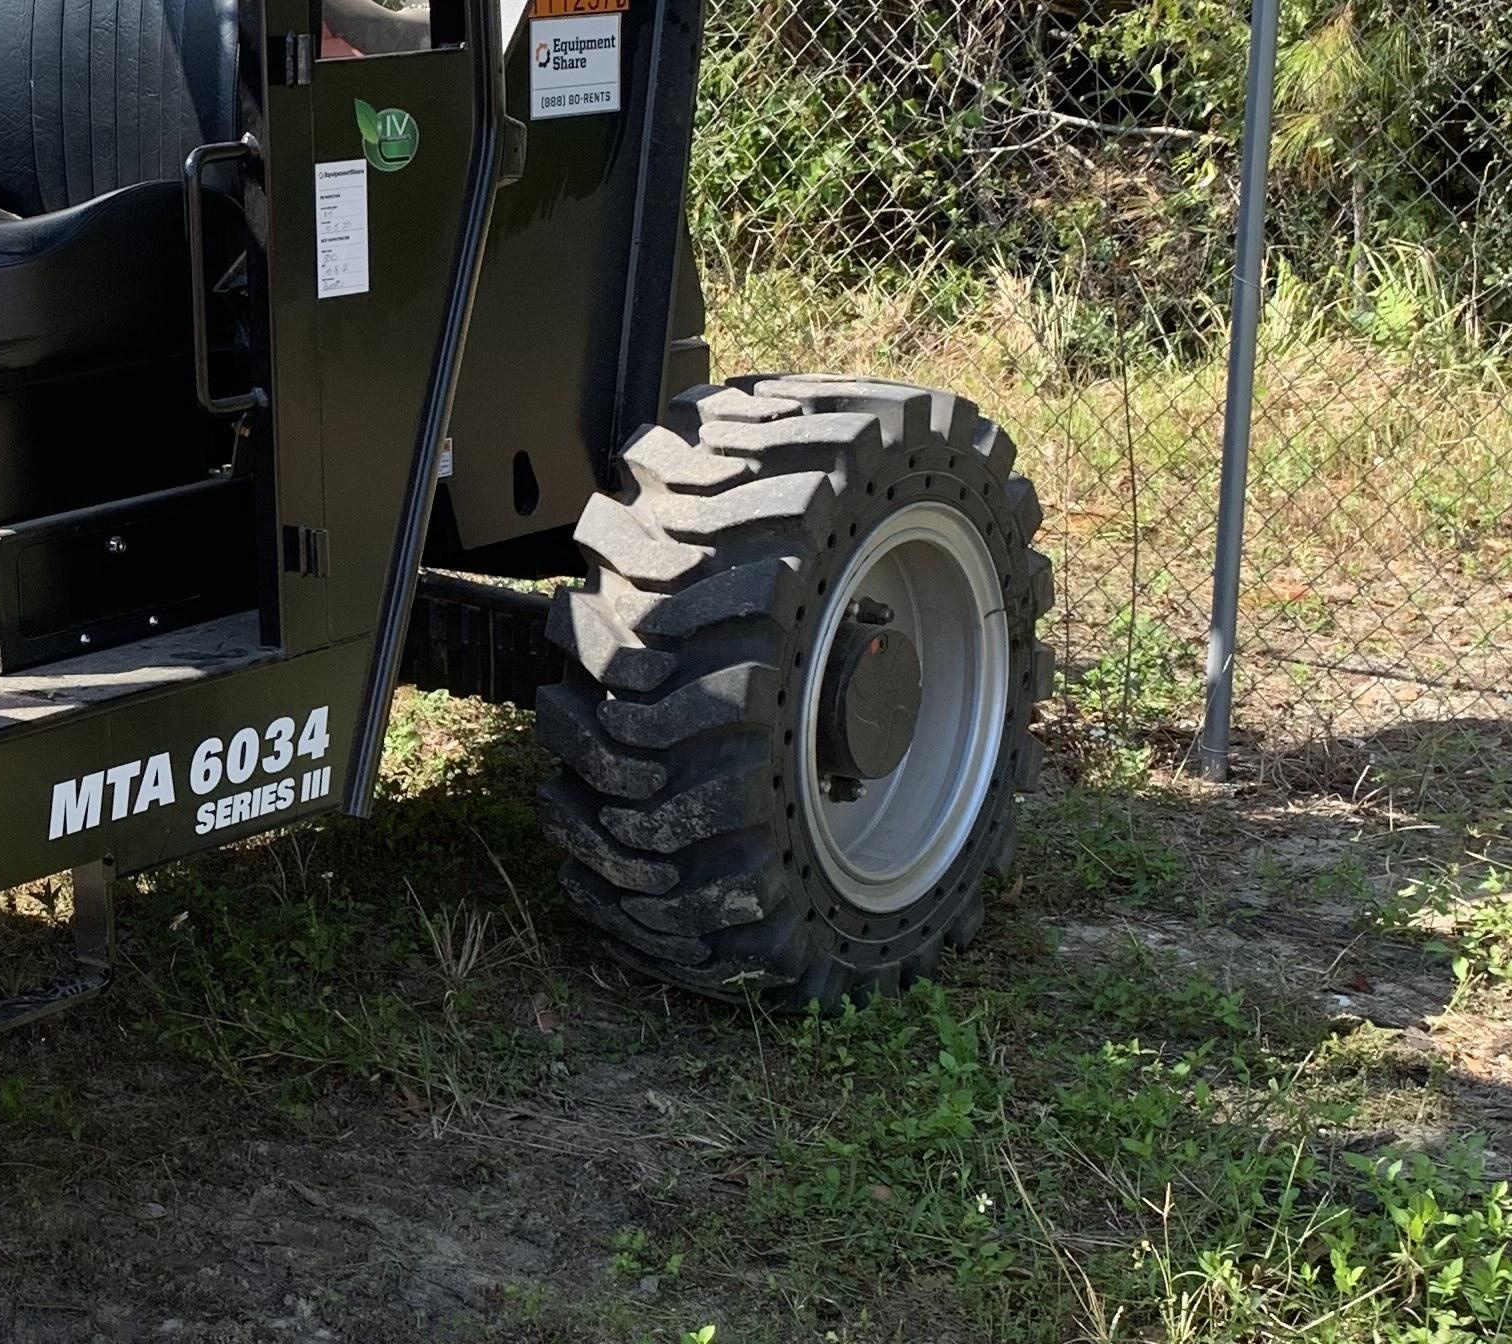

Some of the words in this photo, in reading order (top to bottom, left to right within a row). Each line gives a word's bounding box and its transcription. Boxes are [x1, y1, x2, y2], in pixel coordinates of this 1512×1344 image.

[553, 34, 616, 56] Equipment
[553, 56, 587, 70] Share
[541, 95, 566, 109] (888)
[568, 91, 611, 105] 80-RENTS
[48, 752, 176, 841] MTA
[190, 706, 330, 795] 6034
[195, 777, 296, 835] SERIES
[300, 766, 332, 803] III
